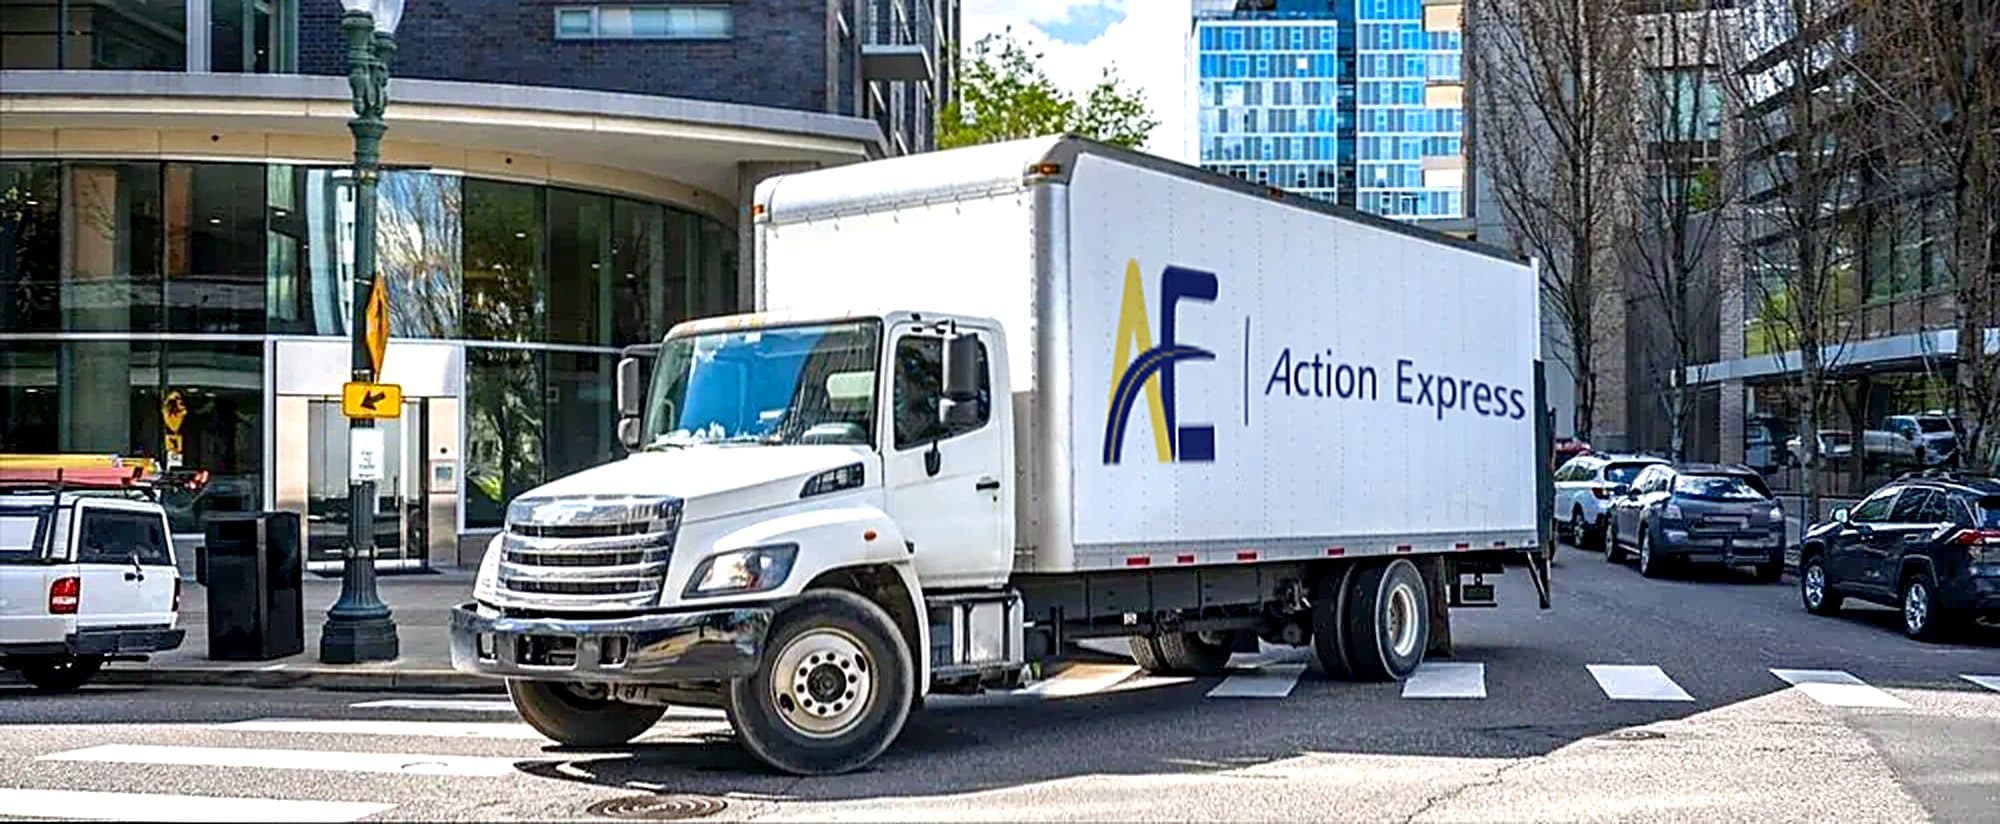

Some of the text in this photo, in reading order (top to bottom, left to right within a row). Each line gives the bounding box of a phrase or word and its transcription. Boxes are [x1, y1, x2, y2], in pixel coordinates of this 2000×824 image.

[1103, 257, 1218, 465] AE
[1265, 347, 1526, 422] Action Express
